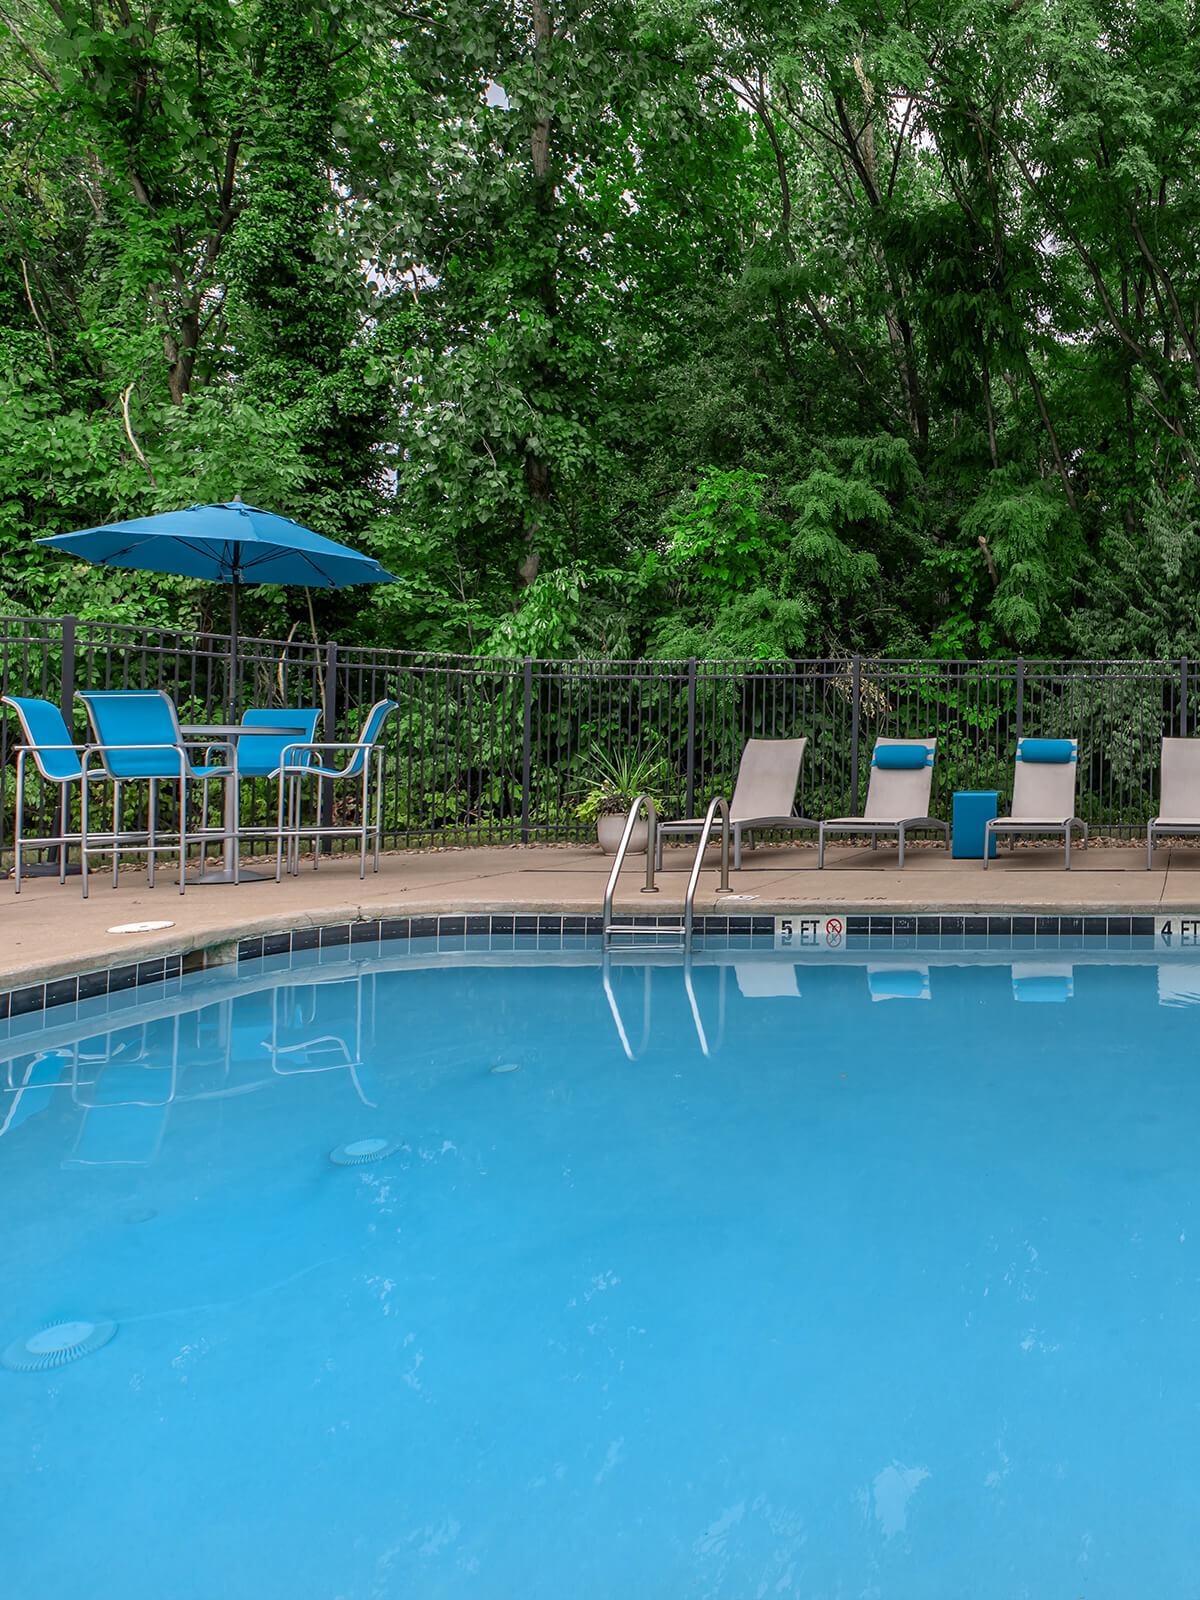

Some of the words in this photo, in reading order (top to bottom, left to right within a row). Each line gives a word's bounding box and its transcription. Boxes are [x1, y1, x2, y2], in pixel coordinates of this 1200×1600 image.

[781, 920, 792, 934] 5
[800, 920, 820, 934] FT
[1161, 920, 1172, 935] 4
[1181, 920, 1200, 935] FT
